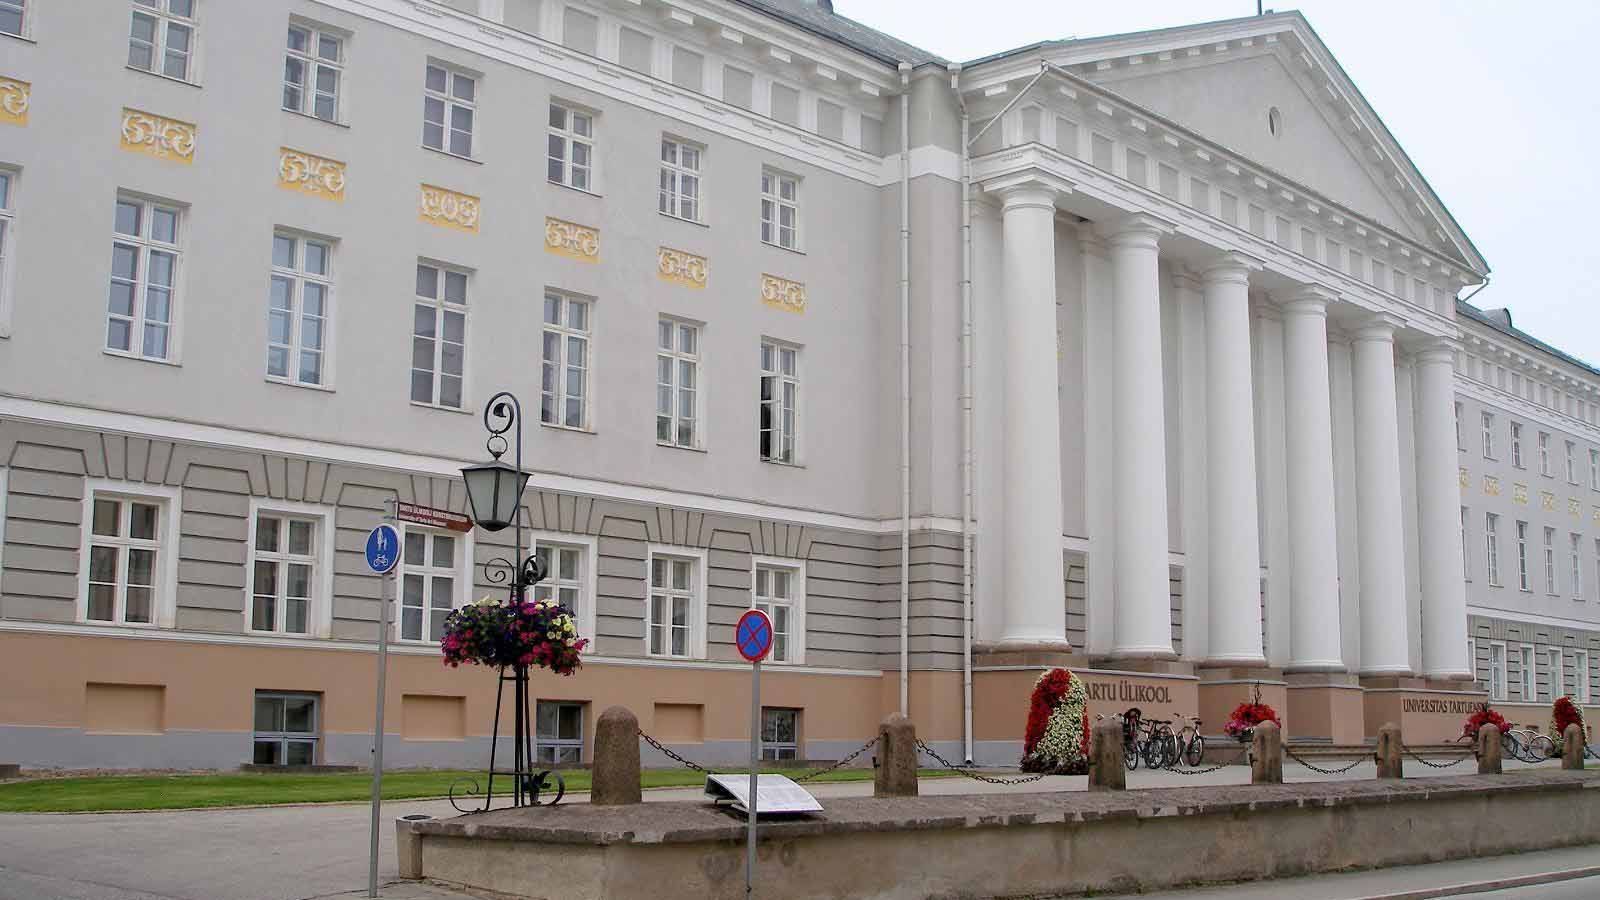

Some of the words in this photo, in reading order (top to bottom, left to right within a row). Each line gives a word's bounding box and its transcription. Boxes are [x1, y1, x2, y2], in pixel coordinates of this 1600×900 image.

[1085, 682, 1116, 701] ARTU
[1119, 680, 1172, 704] ÜLIKOOL
[1403, 698, 1447, 713] UNIVERSITAS
